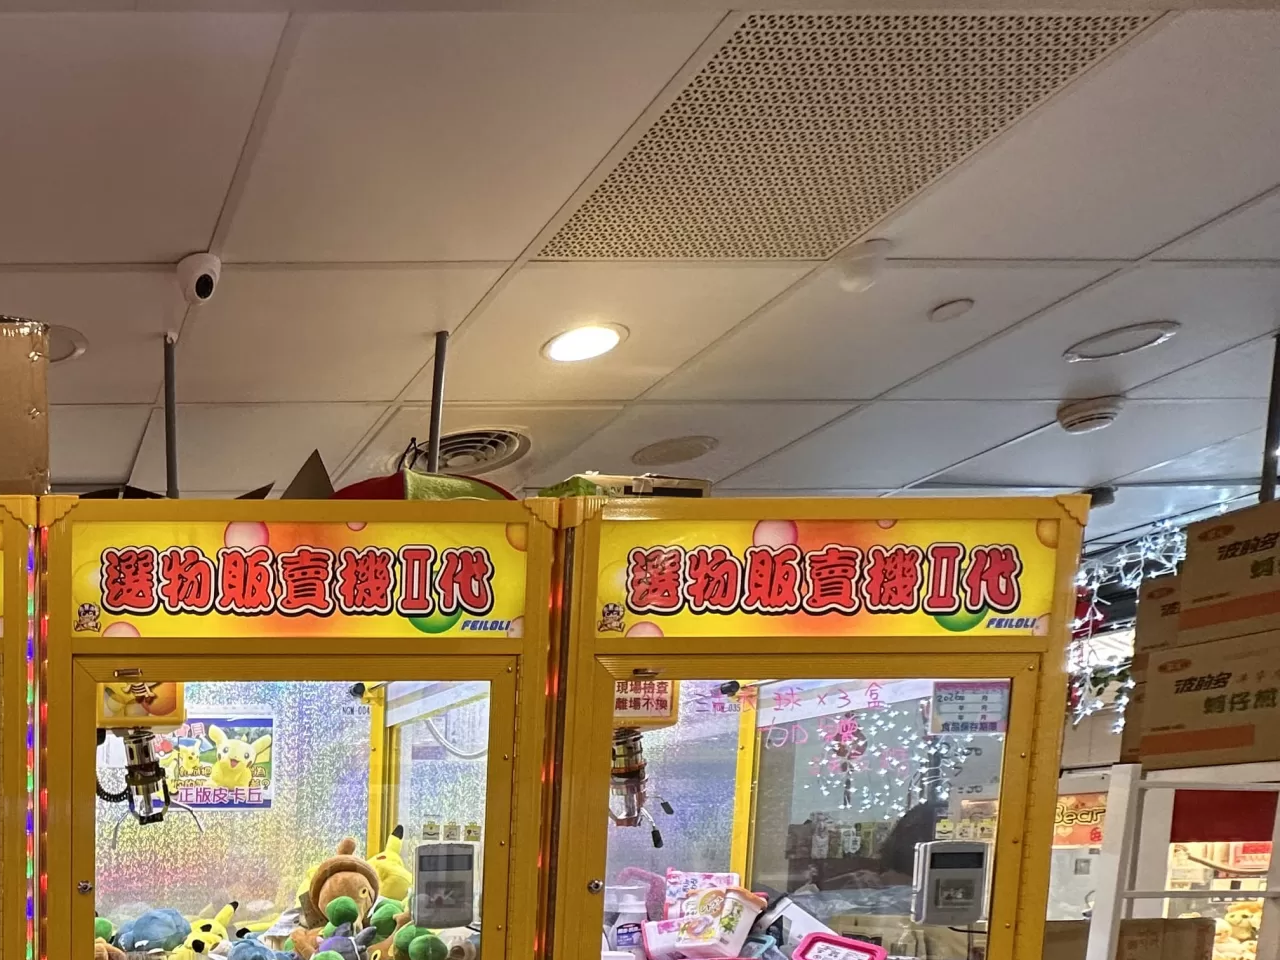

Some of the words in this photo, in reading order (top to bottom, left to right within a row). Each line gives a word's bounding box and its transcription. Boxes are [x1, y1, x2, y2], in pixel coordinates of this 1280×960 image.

[460, 620, 511, 632] FEILOLI
[1203, 687, 1278, 715] 蚵仔煎
[178, 787, 263, 804] 正版皮卡丘
